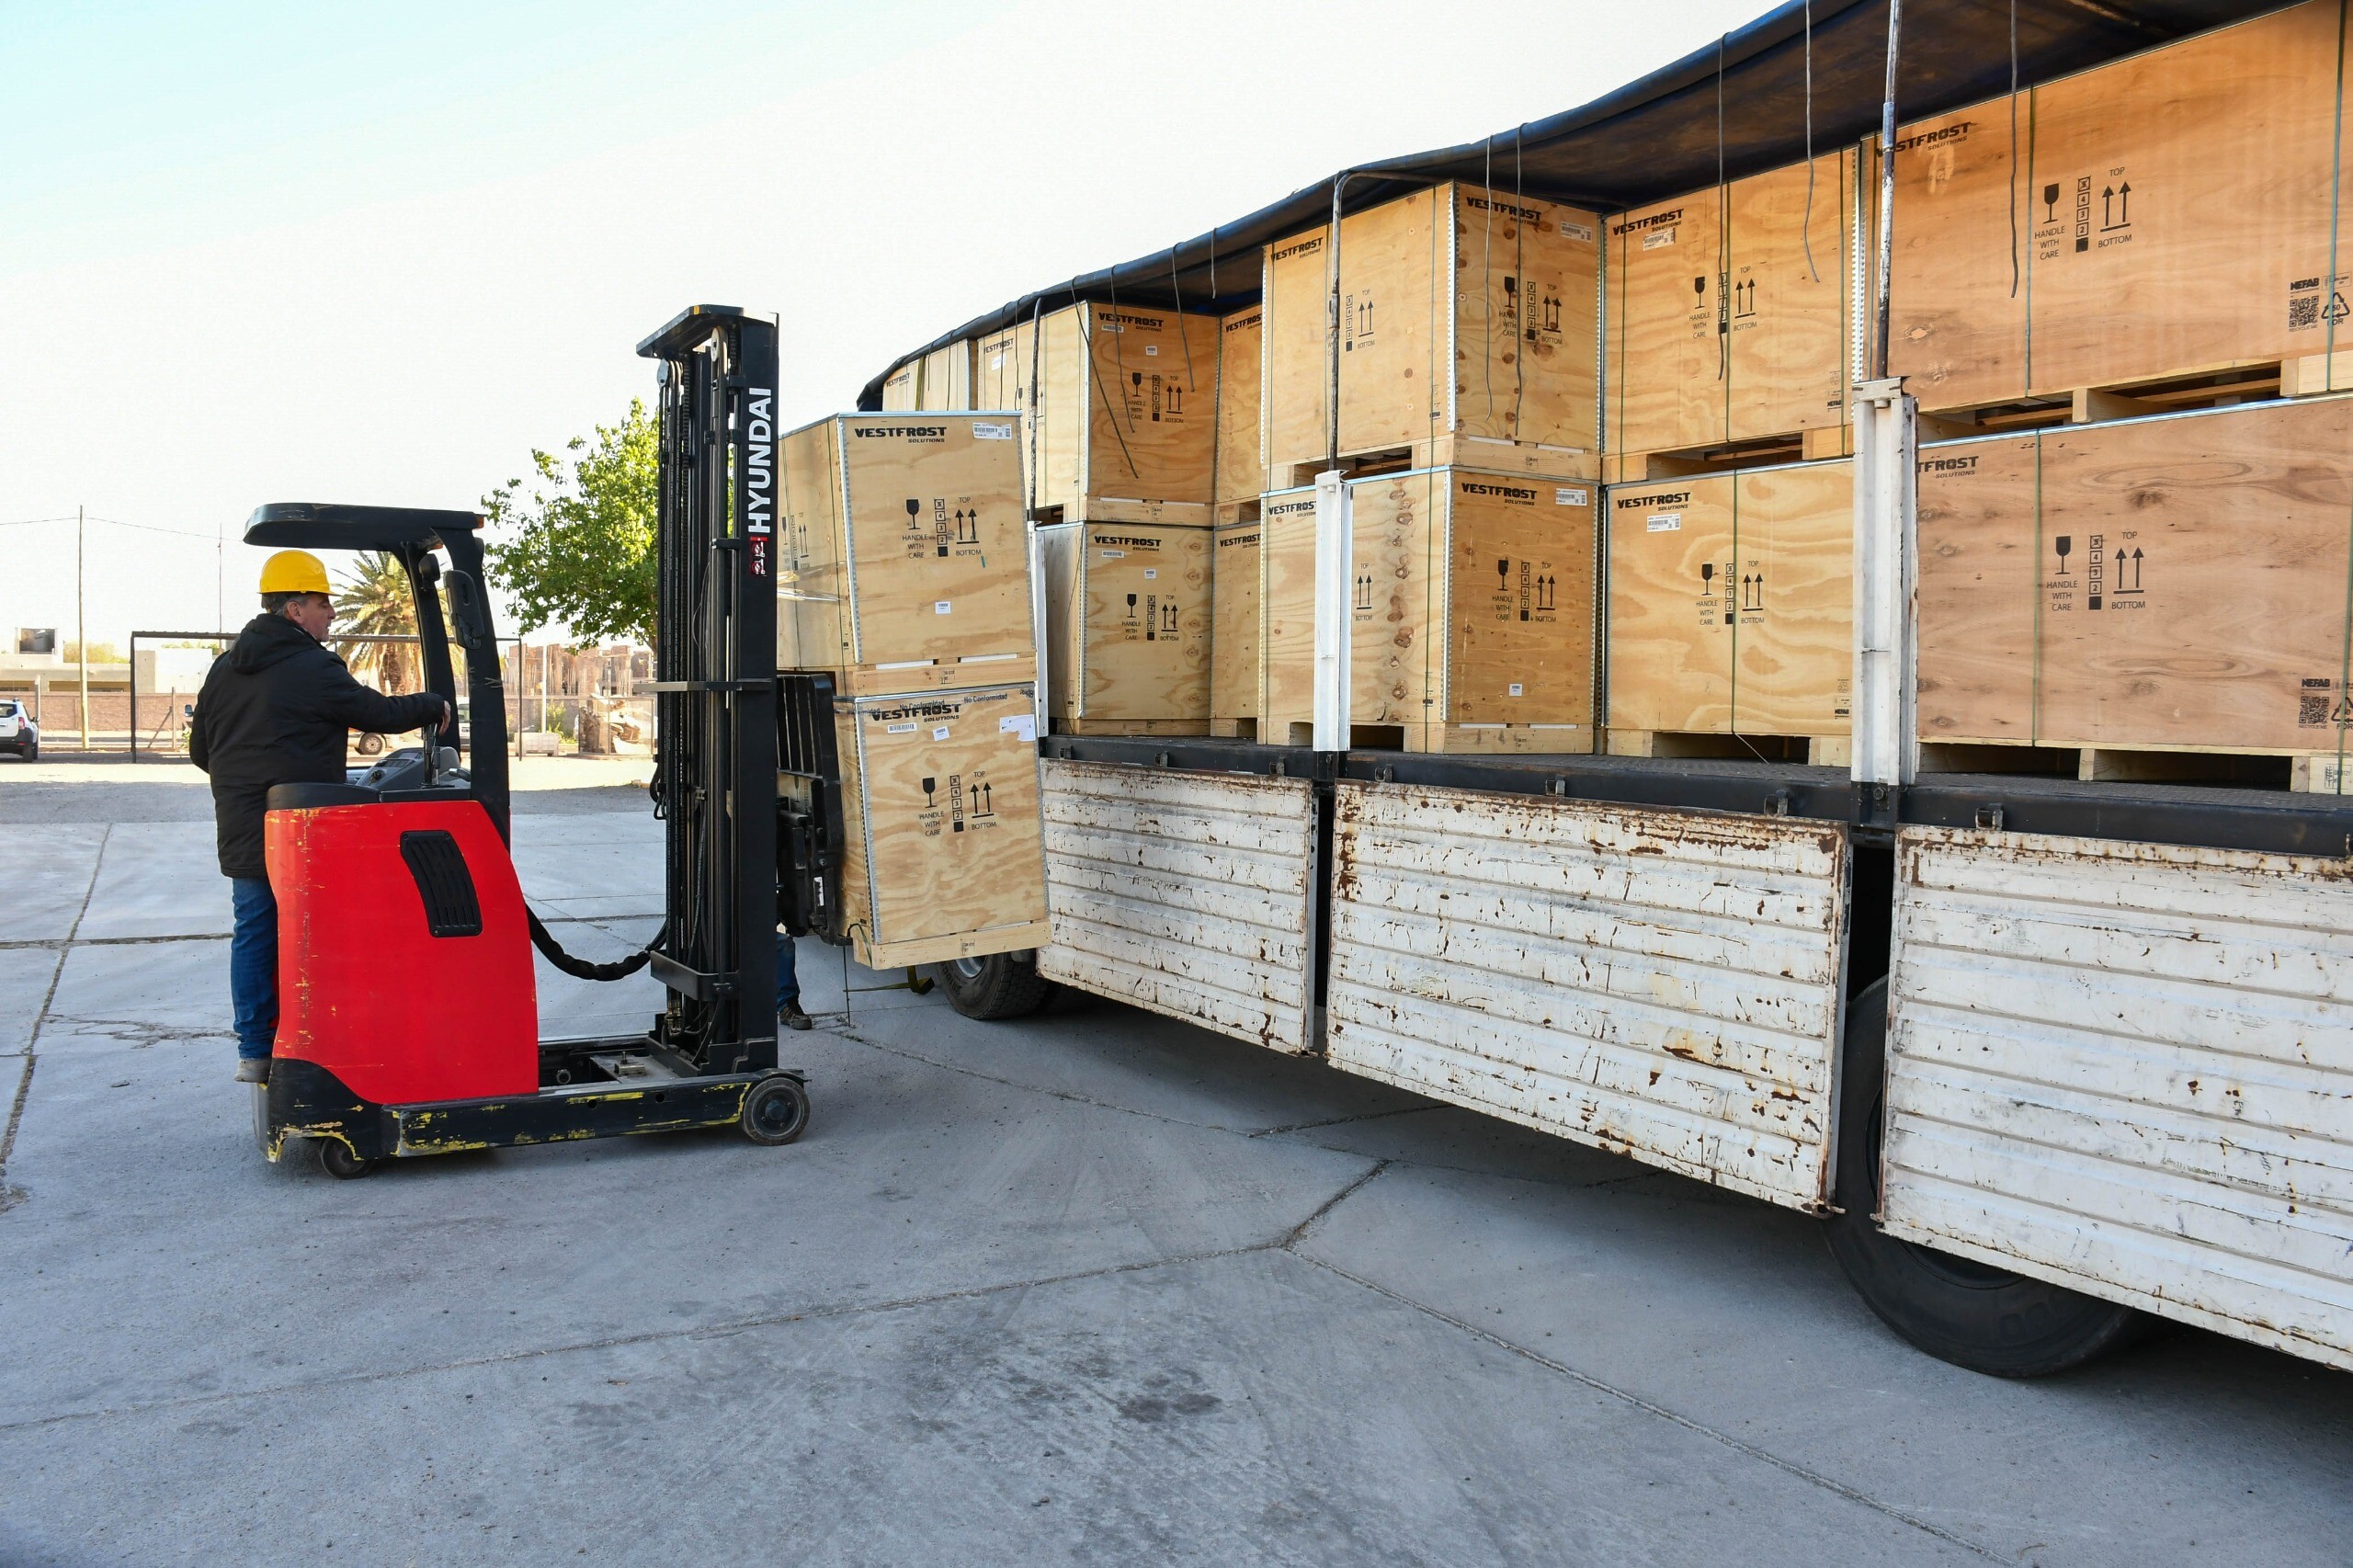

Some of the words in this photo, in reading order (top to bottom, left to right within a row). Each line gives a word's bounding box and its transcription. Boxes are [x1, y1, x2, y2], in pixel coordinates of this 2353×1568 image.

[1875, 121, 1971, 157] VSTFROST
[1927, 136, 1967, 151] SOLUTIONS
[2109, 167, 2125, 177] TOP
[1509, 217, 1540, 227] SOUTIONS
[1612, 209, 1684, 236] VESTFROST
[1652, 221, 1681, 232] SOLUTIONS
[2034, 225, 2065, 239] HANDLE
[2040, 239, 2060, 249] WITH
[2097, 234, 2132, 248] BOTTOM
[1271, 237, 1323, 261] VESTFROST
[2040, 249, 2060, 260] CARE
[2290, 278, 2319, 290] NEFAB
[1098, 312, 1164, 327] VESTFROST
[1689, 312, 1711, 321] HANDLE
[1225, 313, 1262, 333] VESTFROS
[1733, 322, 1757, 331] BOTTOM
[1358, 340, 1375, 349] BOTTOM
[1541, 335, 1563, 345] BOTTOM
[855, 426, 947, 437] VESTFROST
[747, 387, 772, 534] HYUNDAI
[1917, 456, 1979, 472] TFROST
[1935, 470, 1975, 478] SOLUTIONS
[1461, 483, 1537, 499] VESTFROST
[1618, 493, 1690, 509] VESTFROST
[1268, 500, 1316, 515] VESTFROS
[1220, 533, 1260, 547] VESTFROST
[2121, 531, 2137, 540] TOP
[1095, 536, 1161, 547] VESTFROST
[2111, 601, 2145, 609] BOTTOM
[2302, 679, 2330, 687] NEFAB
[872, 703, 961, 721] VESTFROST
[919, 811, 944, 819] HANDLE
[971, 822, 997, 830] BOTTOM
